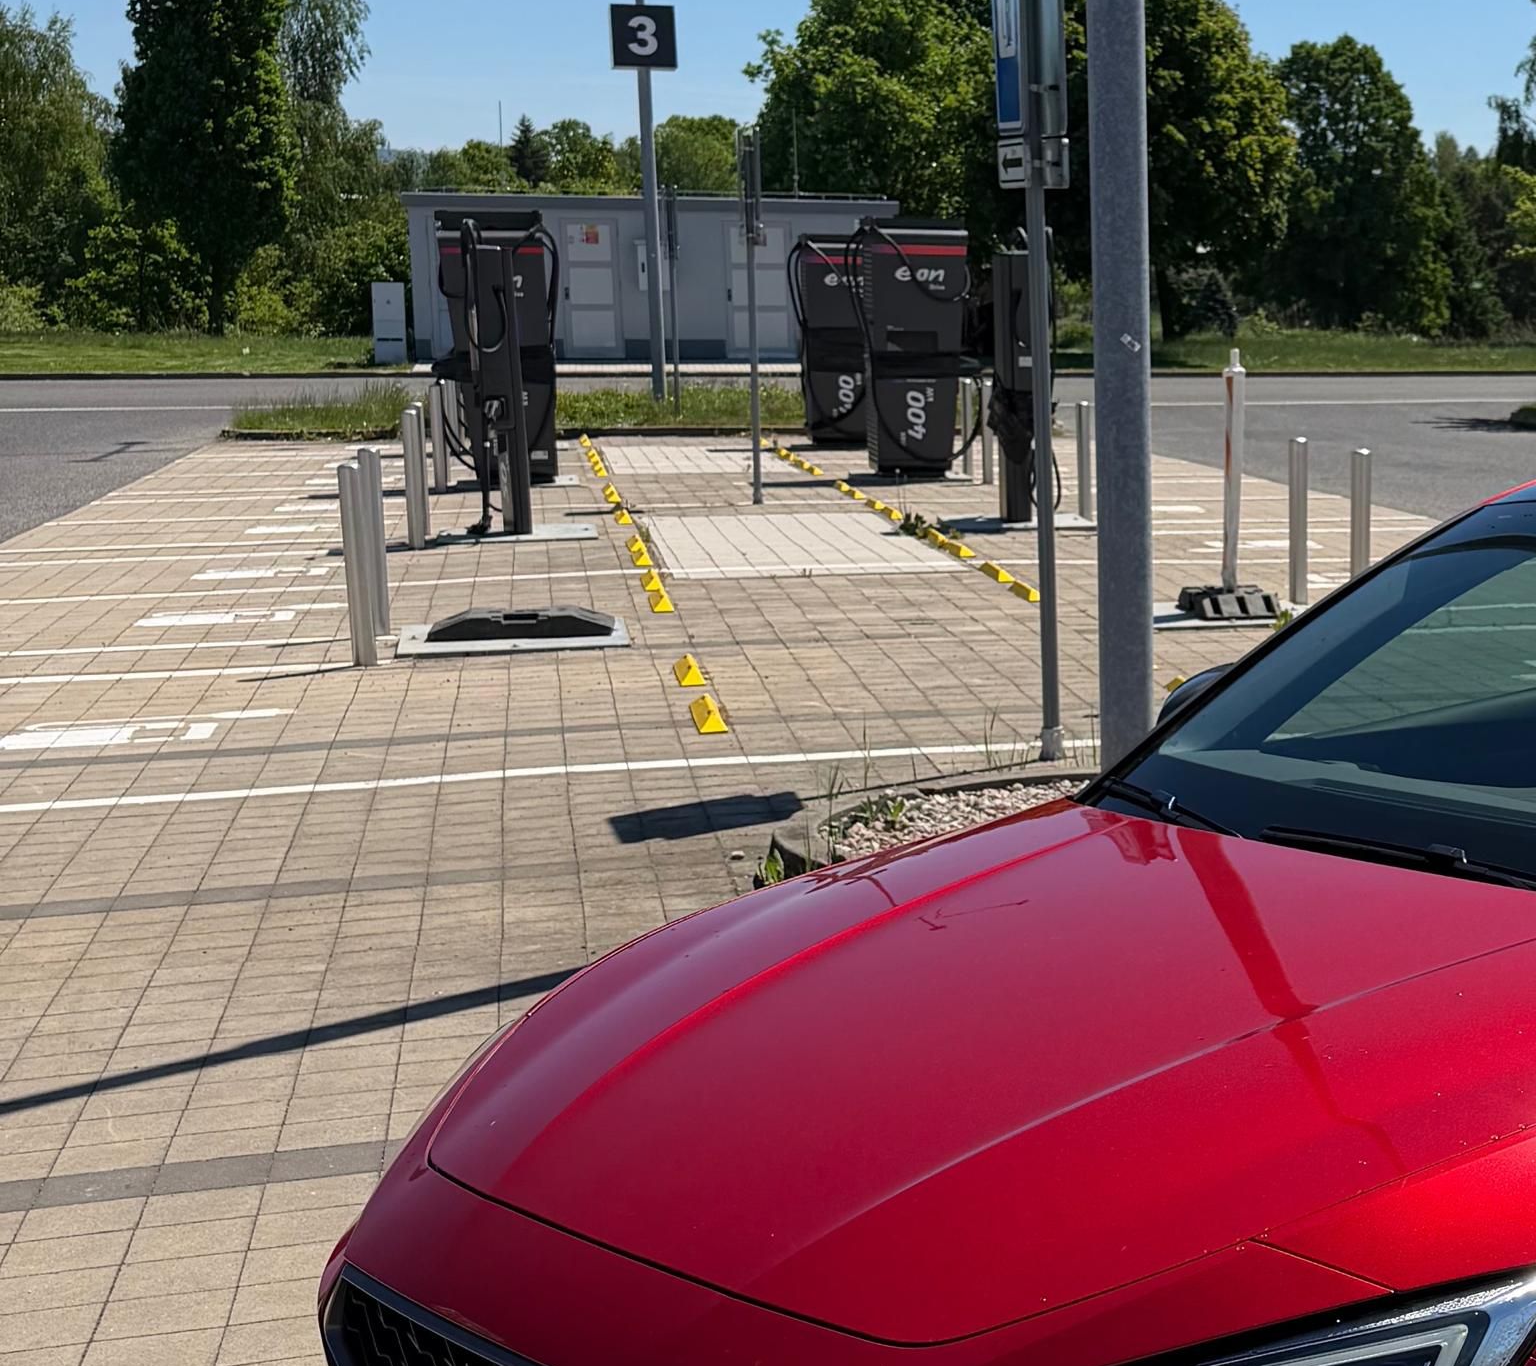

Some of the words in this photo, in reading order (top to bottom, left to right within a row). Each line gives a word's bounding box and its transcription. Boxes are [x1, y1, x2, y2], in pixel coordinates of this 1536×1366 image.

[627, 15, 659, 57] 3
[895, 265, 945, 282] eon
[905, 390, 926, 440] 400
